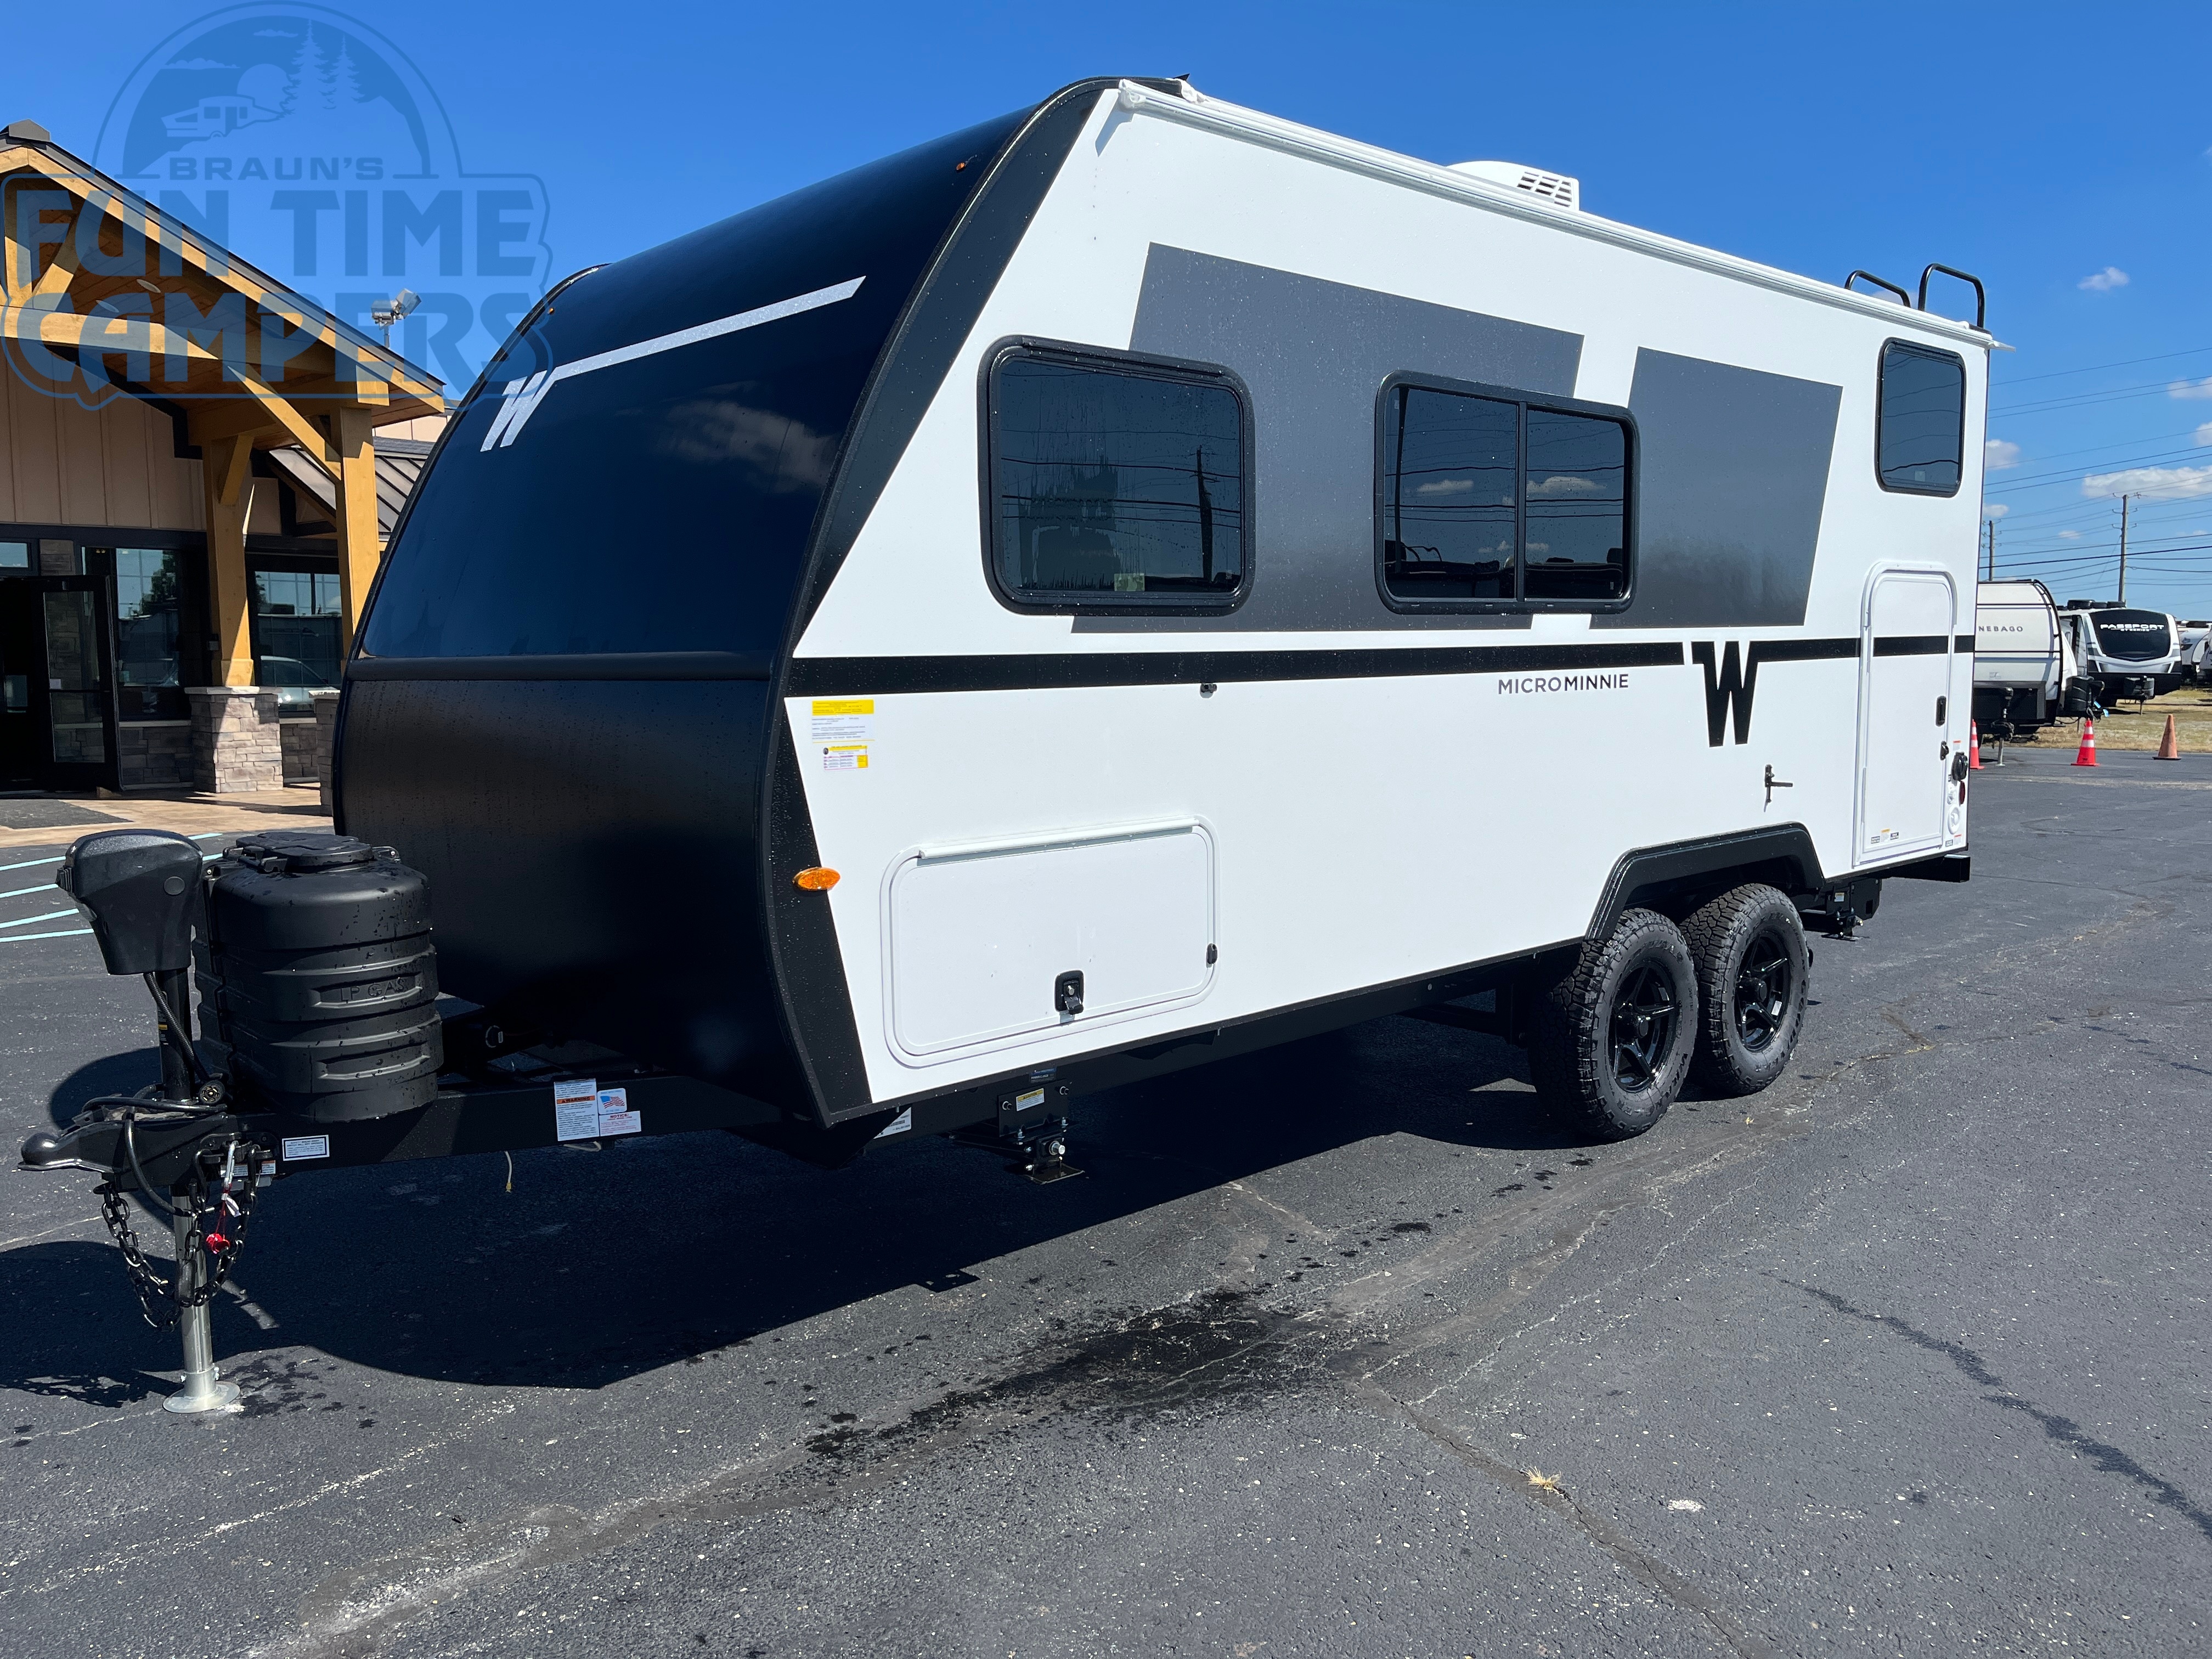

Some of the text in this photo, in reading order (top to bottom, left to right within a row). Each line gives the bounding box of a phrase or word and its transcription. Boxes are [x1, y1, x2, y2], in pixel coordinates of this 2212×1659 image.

[1498, 673, 1629, 695] MICROMINNIE
[340, 978, 405, 1002] LP GAS
